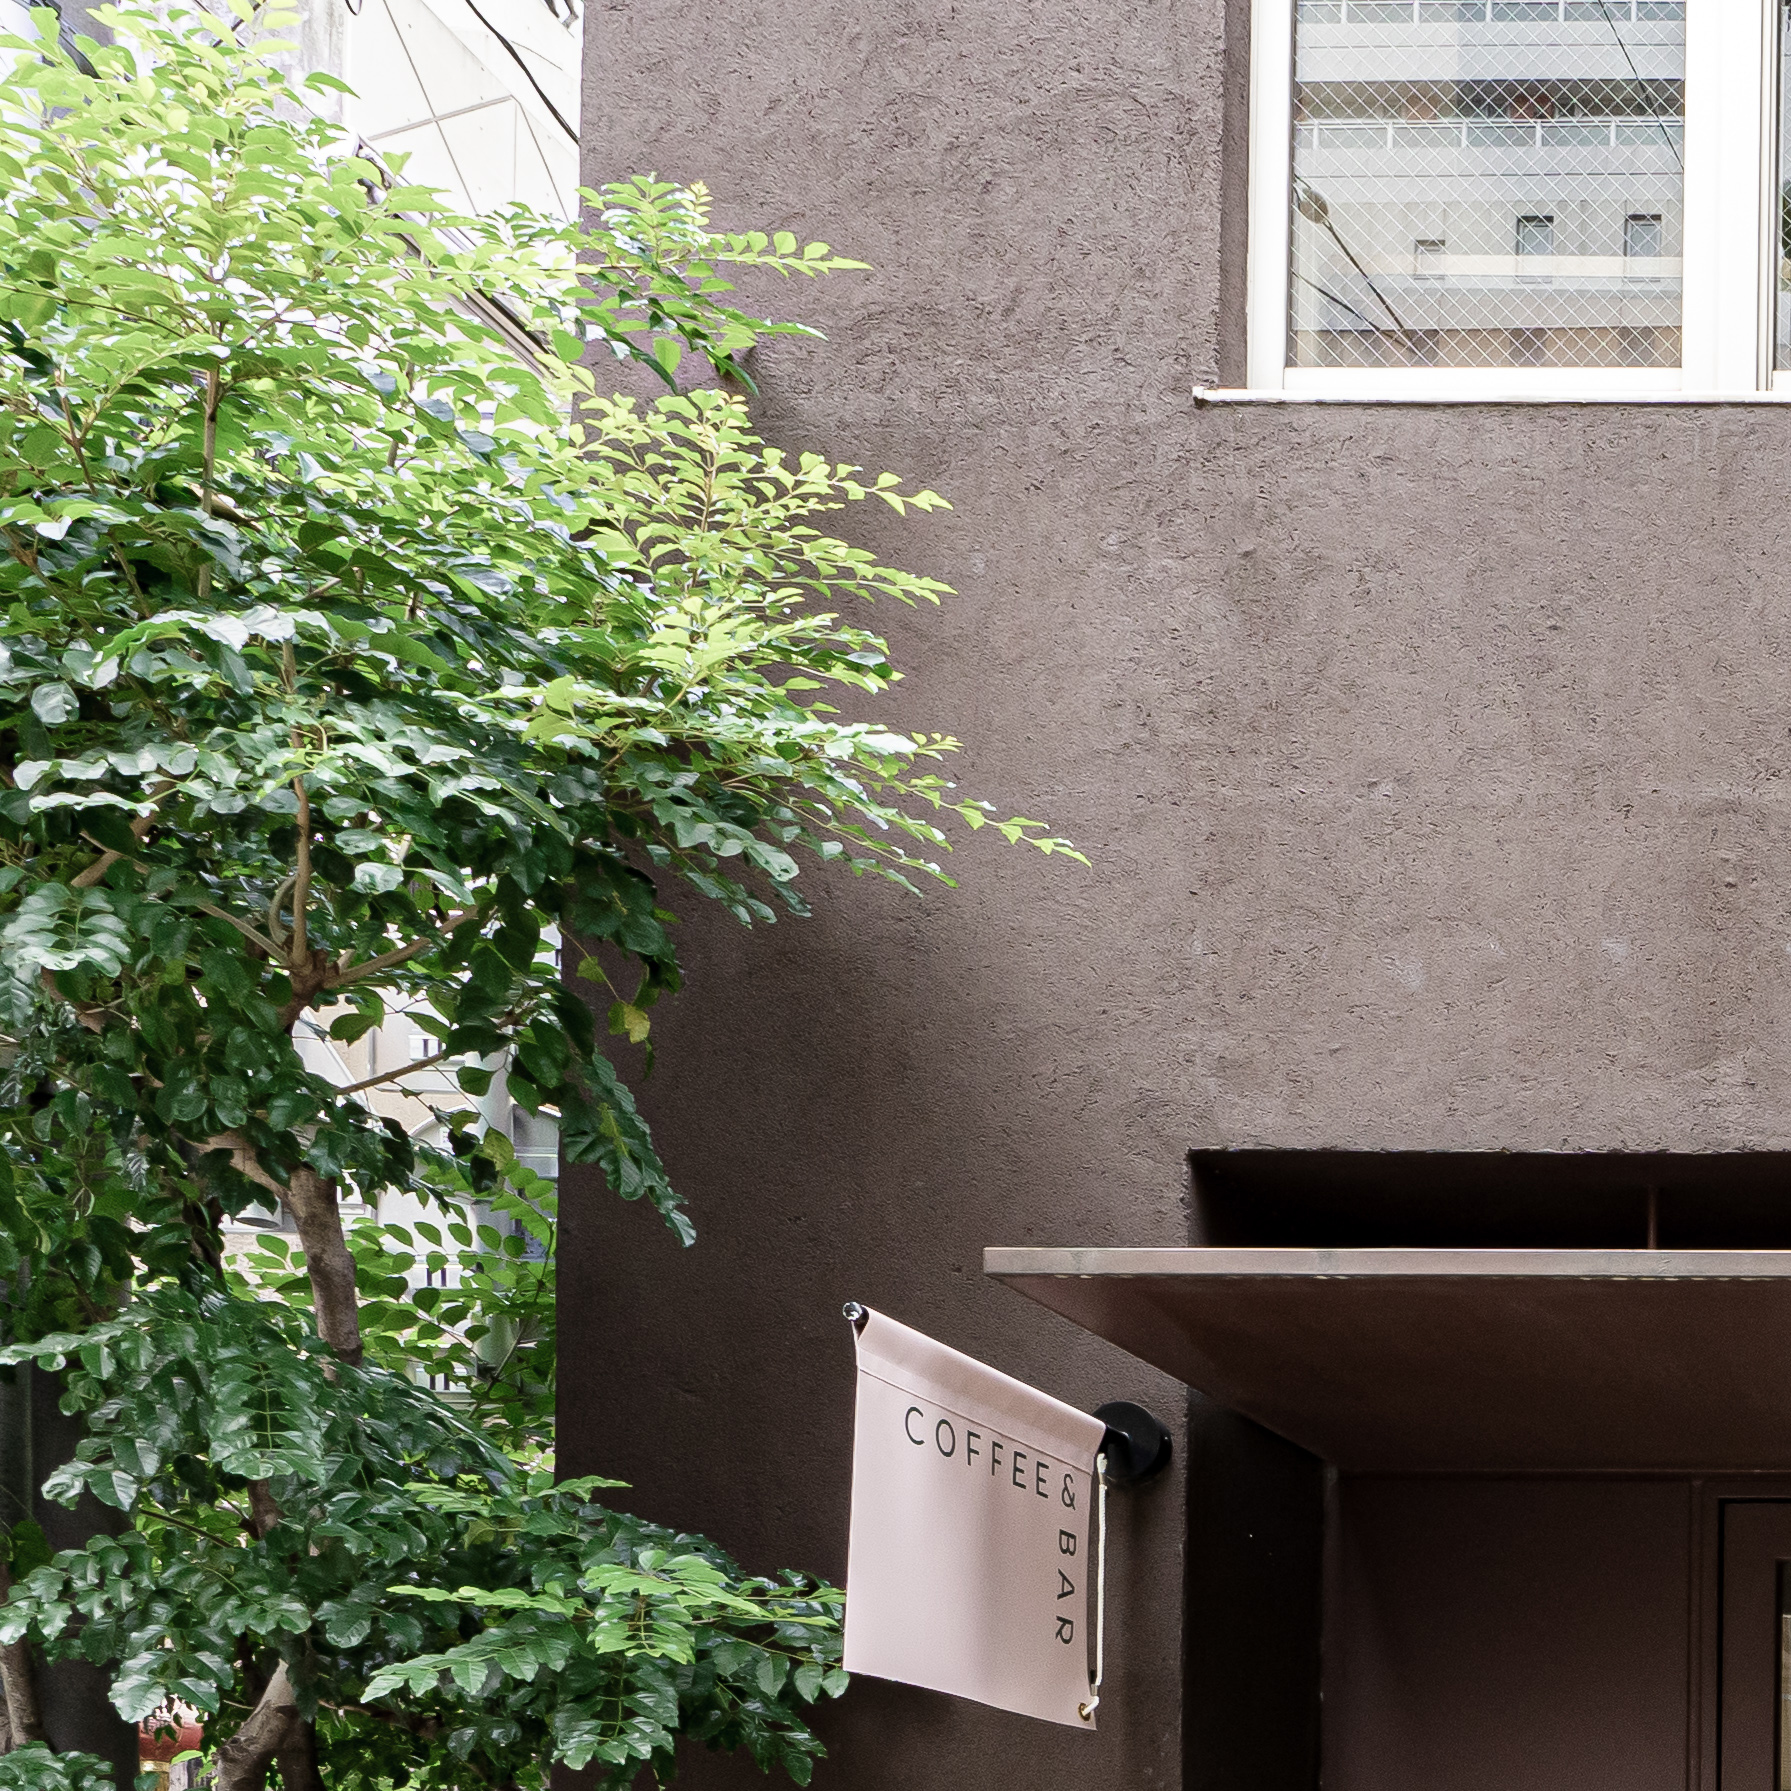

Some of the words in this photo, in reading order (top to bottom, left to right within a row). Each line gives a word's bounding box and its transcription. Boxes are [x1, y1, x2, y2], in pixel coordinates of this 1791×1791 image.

[904, 1405, 1050, 1500] COFFEE
[1061, 1473, 1077, 1511] &
[1055, 1528, 1078, 1646] BAR
